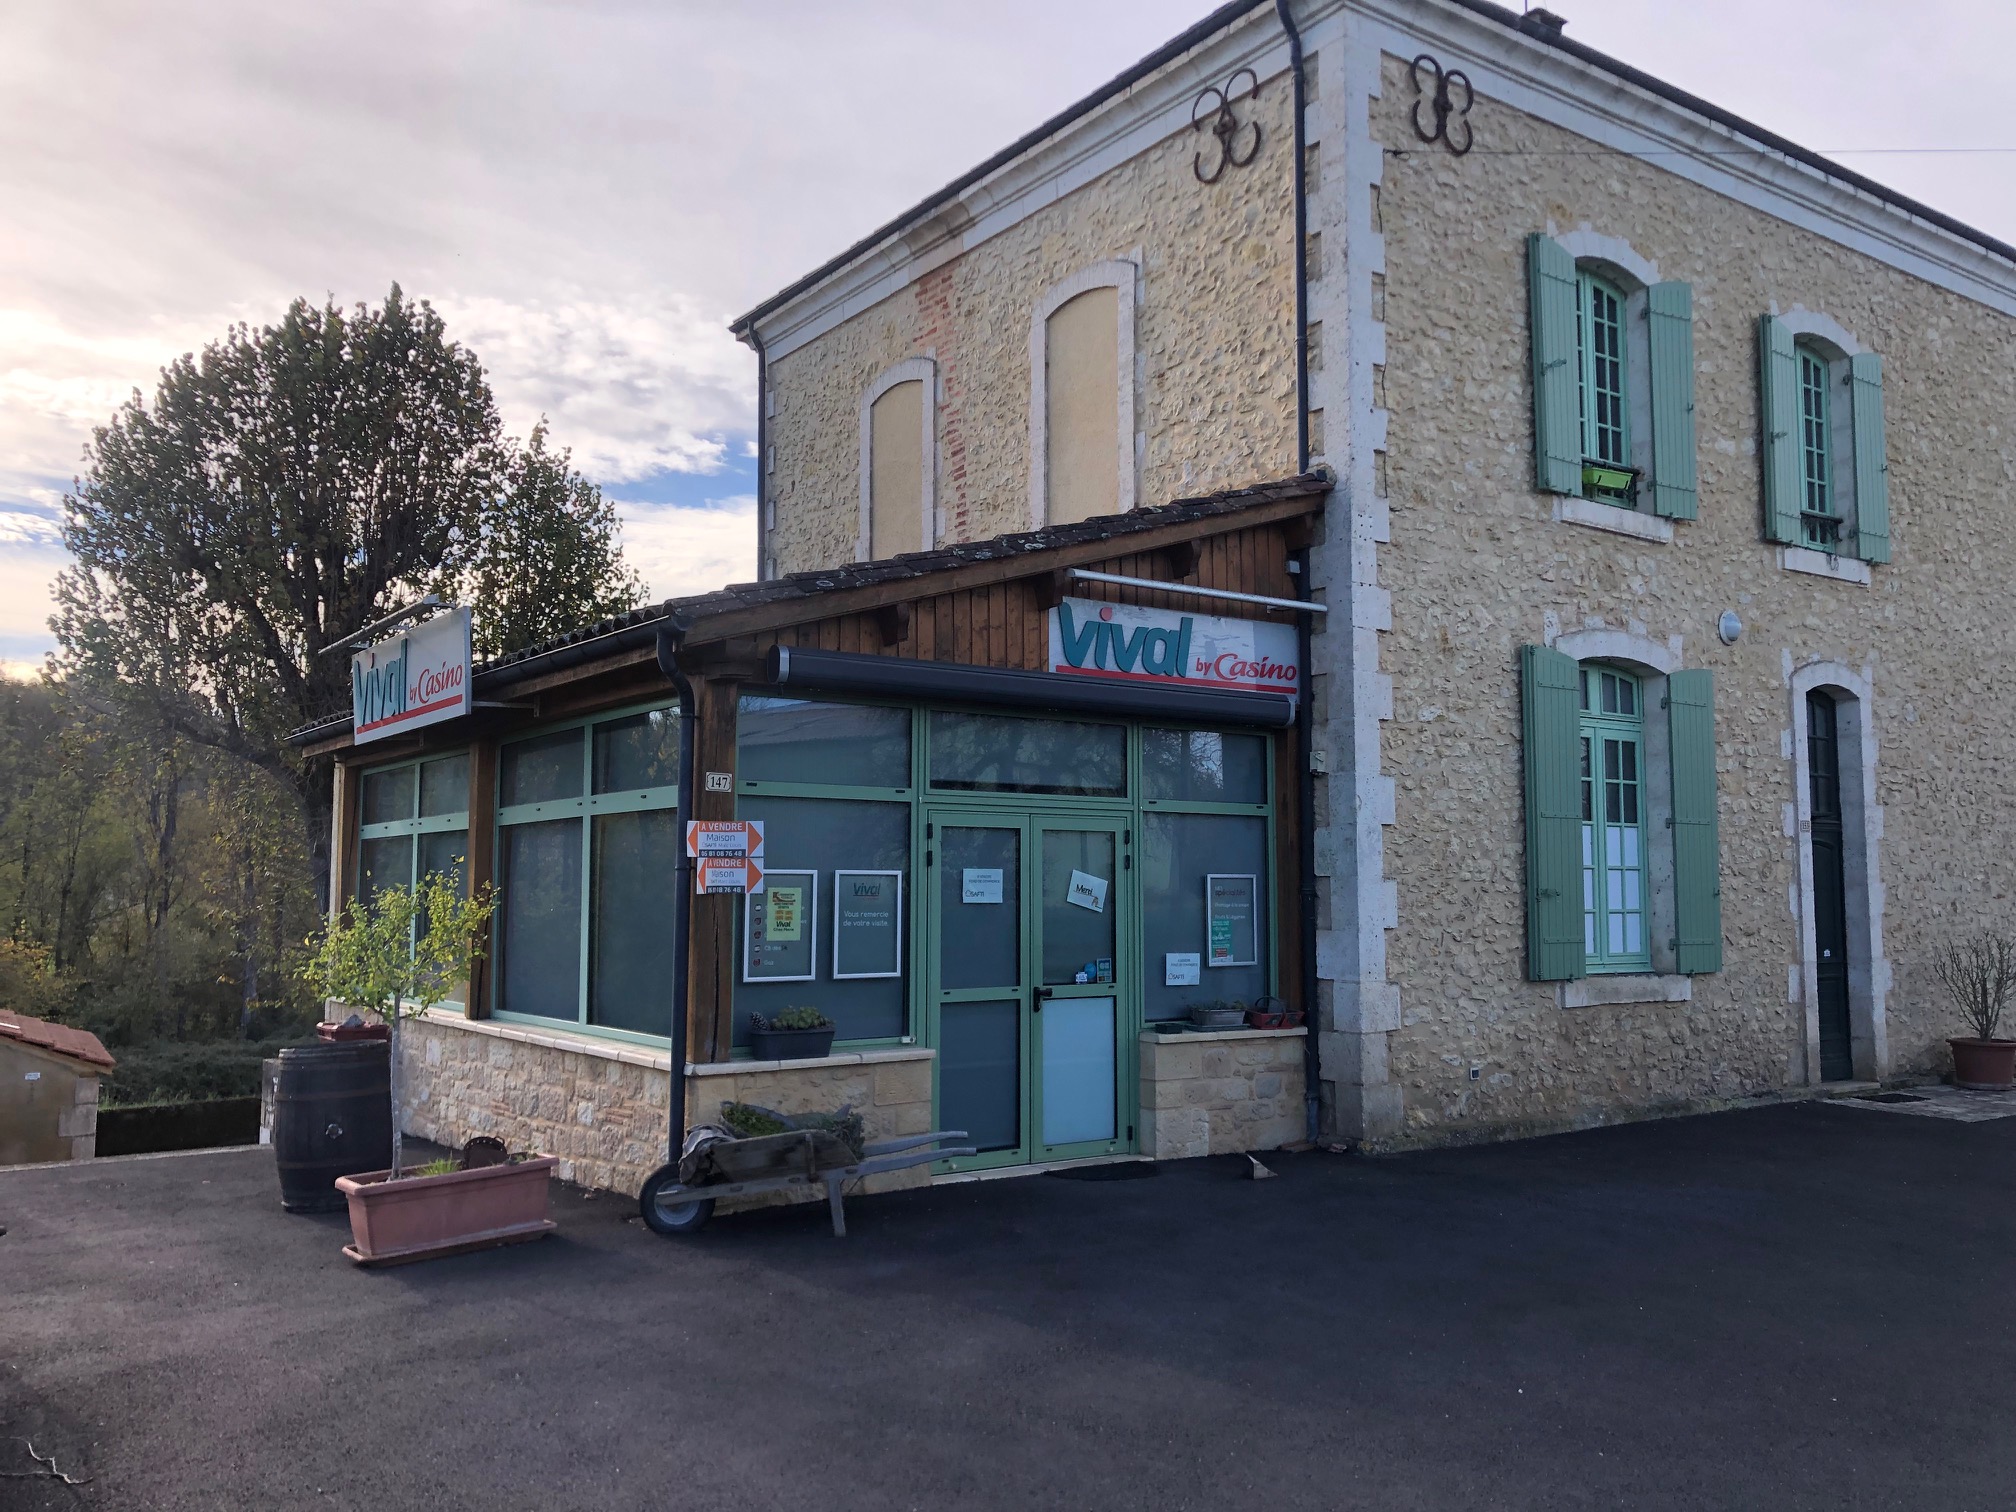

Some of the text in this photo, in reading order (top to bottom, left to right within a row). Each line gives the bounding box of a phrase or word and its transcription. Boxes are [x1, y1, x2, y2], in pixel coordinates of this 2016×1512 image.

[1057, 601, 1297, 681] Vival by Casino
[352, 638, 463, 727] Vival by Casino
[710, 775, 728, 789] 147
[701, 822, 743, 831] A VENDRE
[706, 833, 736, 842] Maison
[712, 858, 742, 867] VENDRE
[853, 882, 881, 896] Vival
[843, 910, 889, 918] Vous remercie
